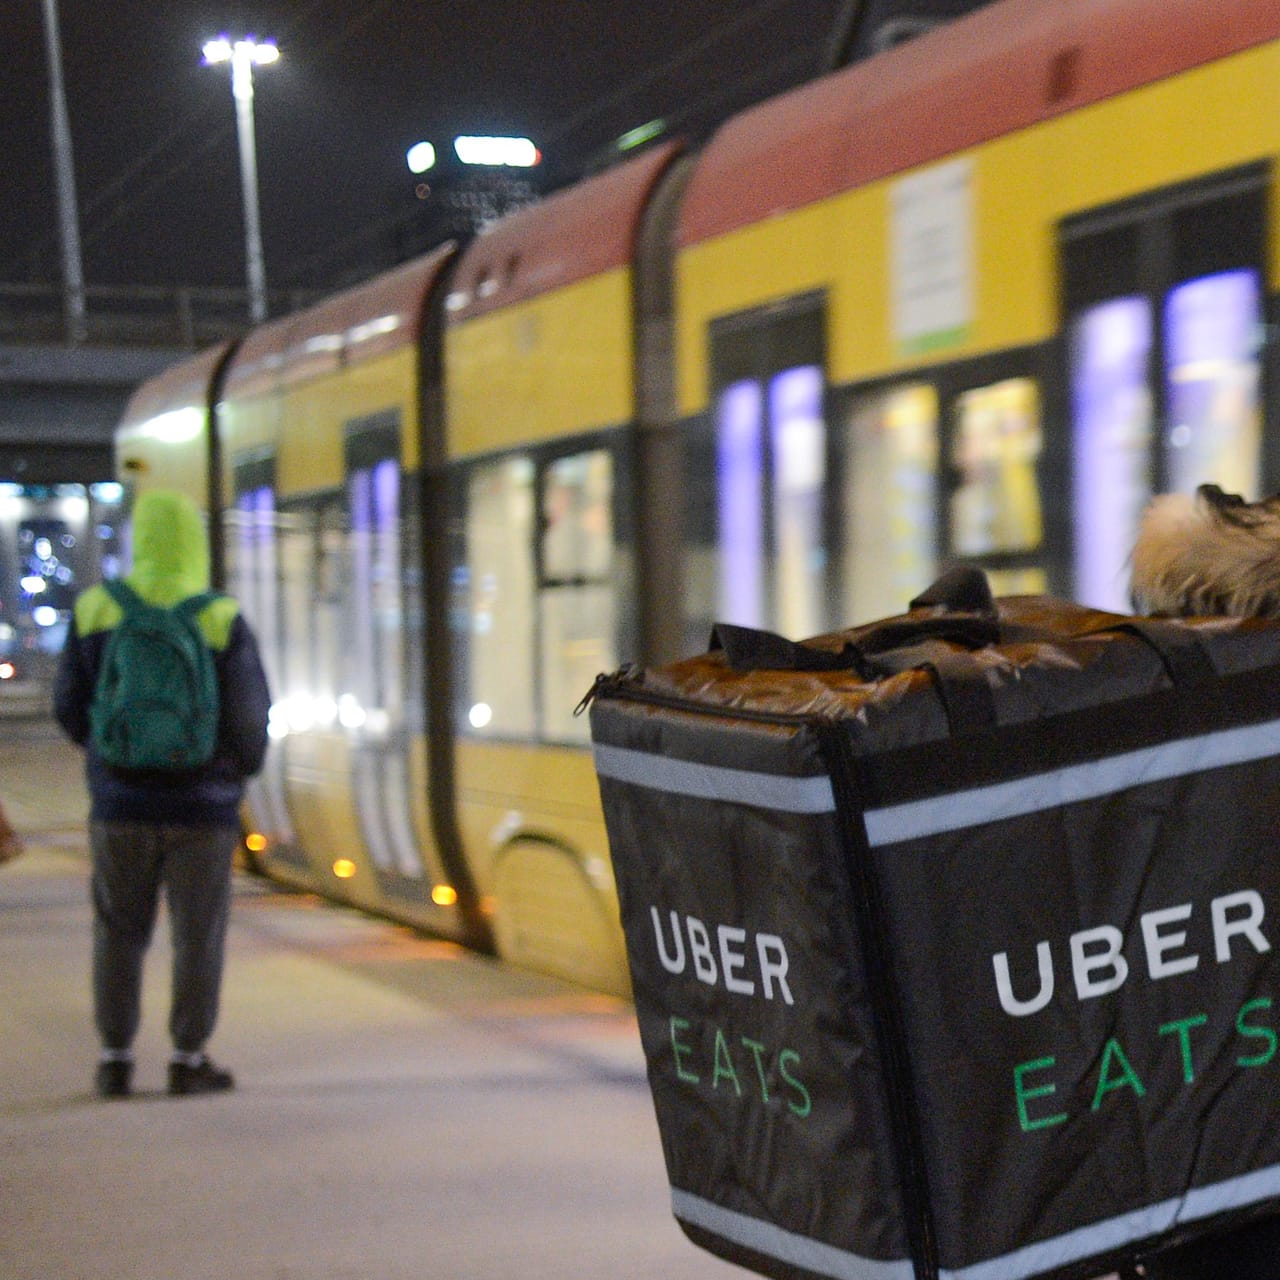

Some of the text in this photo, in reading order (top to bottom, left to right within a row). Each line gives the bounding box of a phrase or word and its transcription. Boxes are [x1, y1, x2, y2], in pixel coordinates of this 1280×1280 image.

[651, 906, 794, 1005] UBER
[992, 890, 1271, 1017] UBER
[670, 1018, 812, 1118] EATS
[1014, 998, 1279, 1132] EATS
